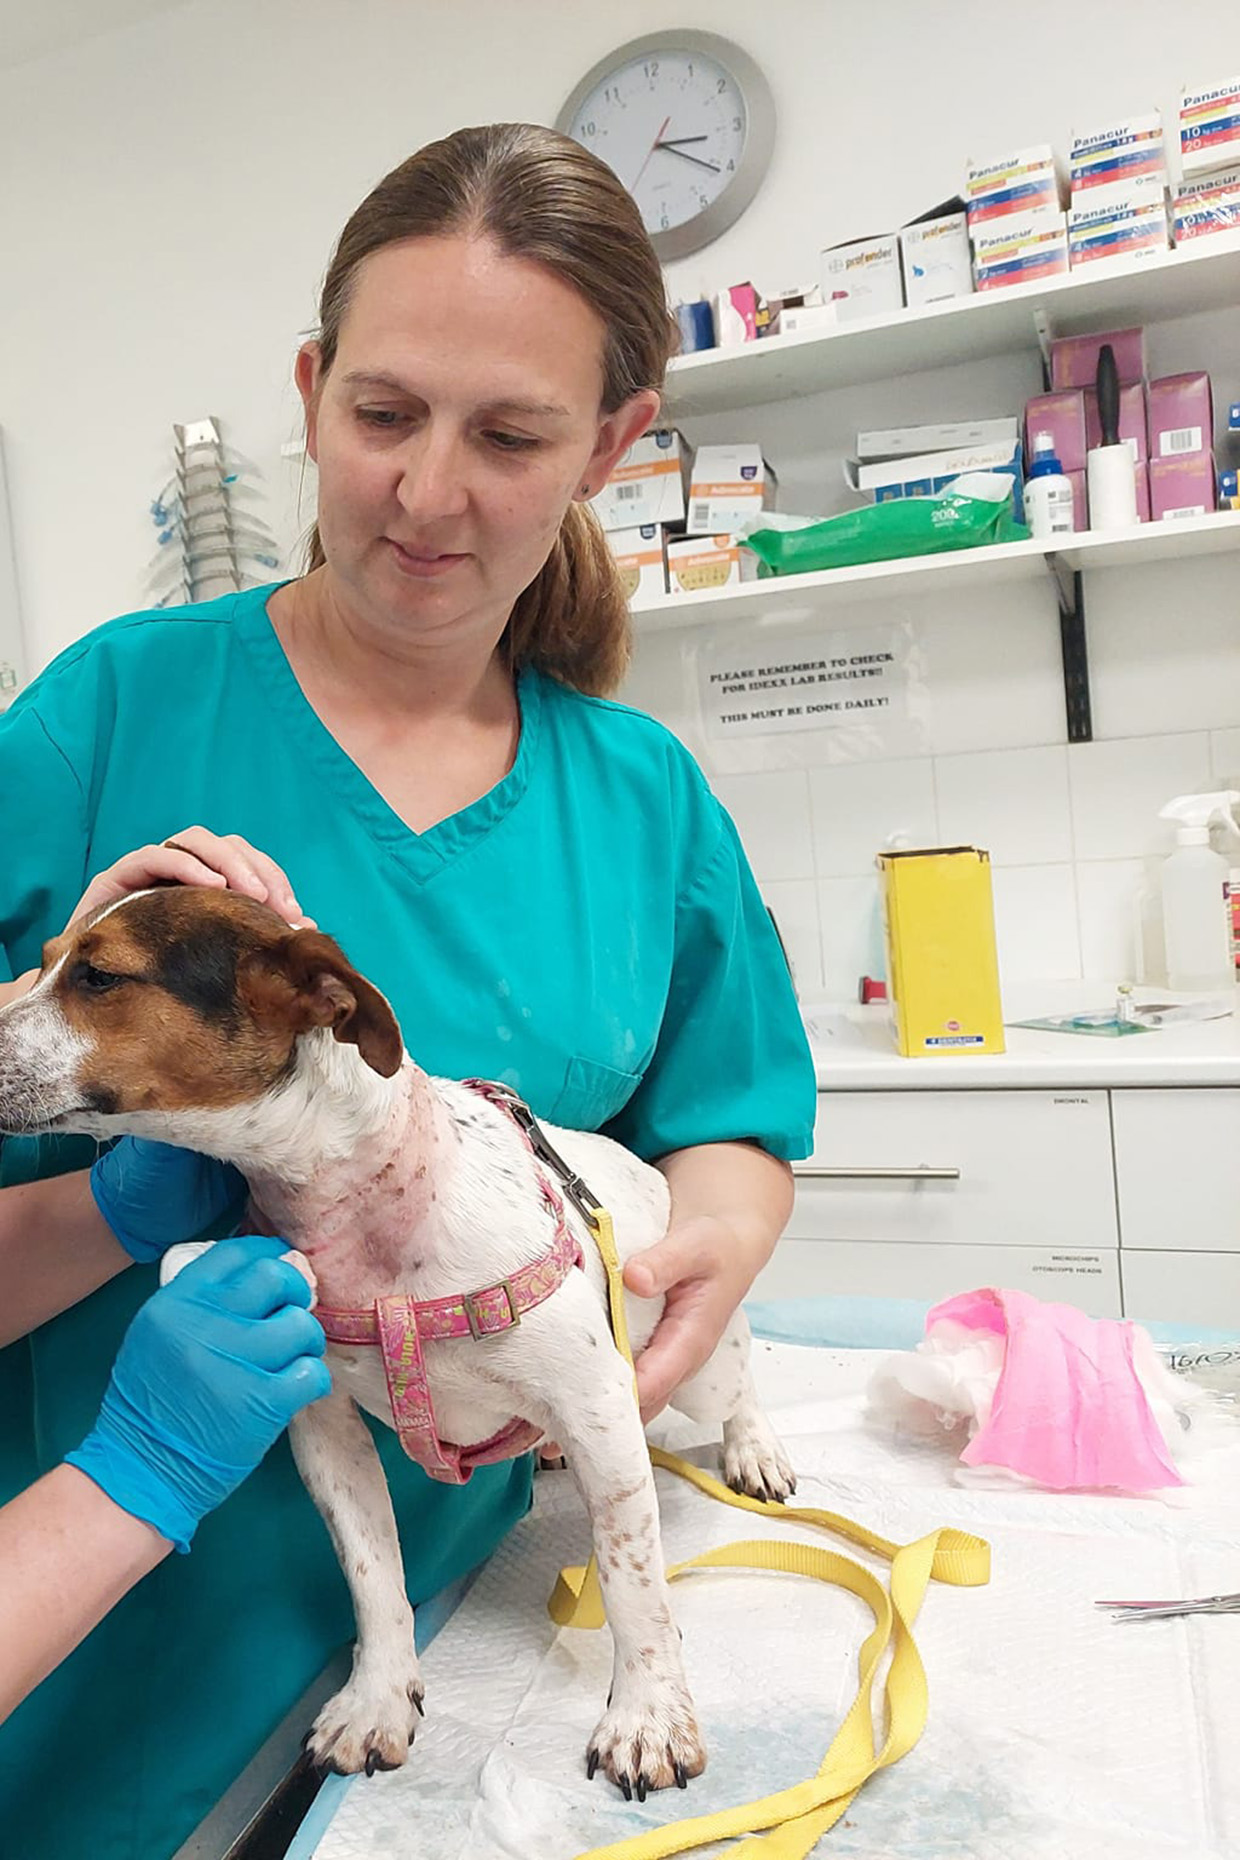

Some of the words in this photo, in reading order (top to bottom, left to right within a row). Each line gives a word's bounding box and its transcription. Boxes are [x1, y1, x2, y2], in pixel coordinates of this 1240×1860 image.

[643, 62, 659, 78] 12
[687, 64, 694, 77] 1
[604, 87, 620, 102] 11
[716, 79, 727, 94] 2
[580, 122, 596, 138] 10
[732, 117, 742, 132] 3
[1074, 127, 1129, 149] Panacur
[1186, 127, 1201, 139] 10
[726, 159, 735, 172] 4
[969, 159, 1020, 180] Panacur
[1178, 175, 1237, 197] Panacur
[1073, 203, 1129, 222] Panacur
[661, 216, 670, 230] 6
[980, 227, 1033, 248] Panacur
[710, 669, 755, 683] PLEASE
[758, 660, 827, 677] REMEMBER
[831, 658, 847, 668] TO
[850, 652, 894, 667] CHECK
[722, 682, 746, 695] FOR
[749, 677, 788, 692] IDEXX
[791, 674, 815, 687] LAB
[720, 713, 748, 724] THIS
[751, 708, 785, 721] MUST
[787, 706, 804, 717] BE
[806, 702, 842, 715] DONE
[845, 697, 890, 711] DAILY!
